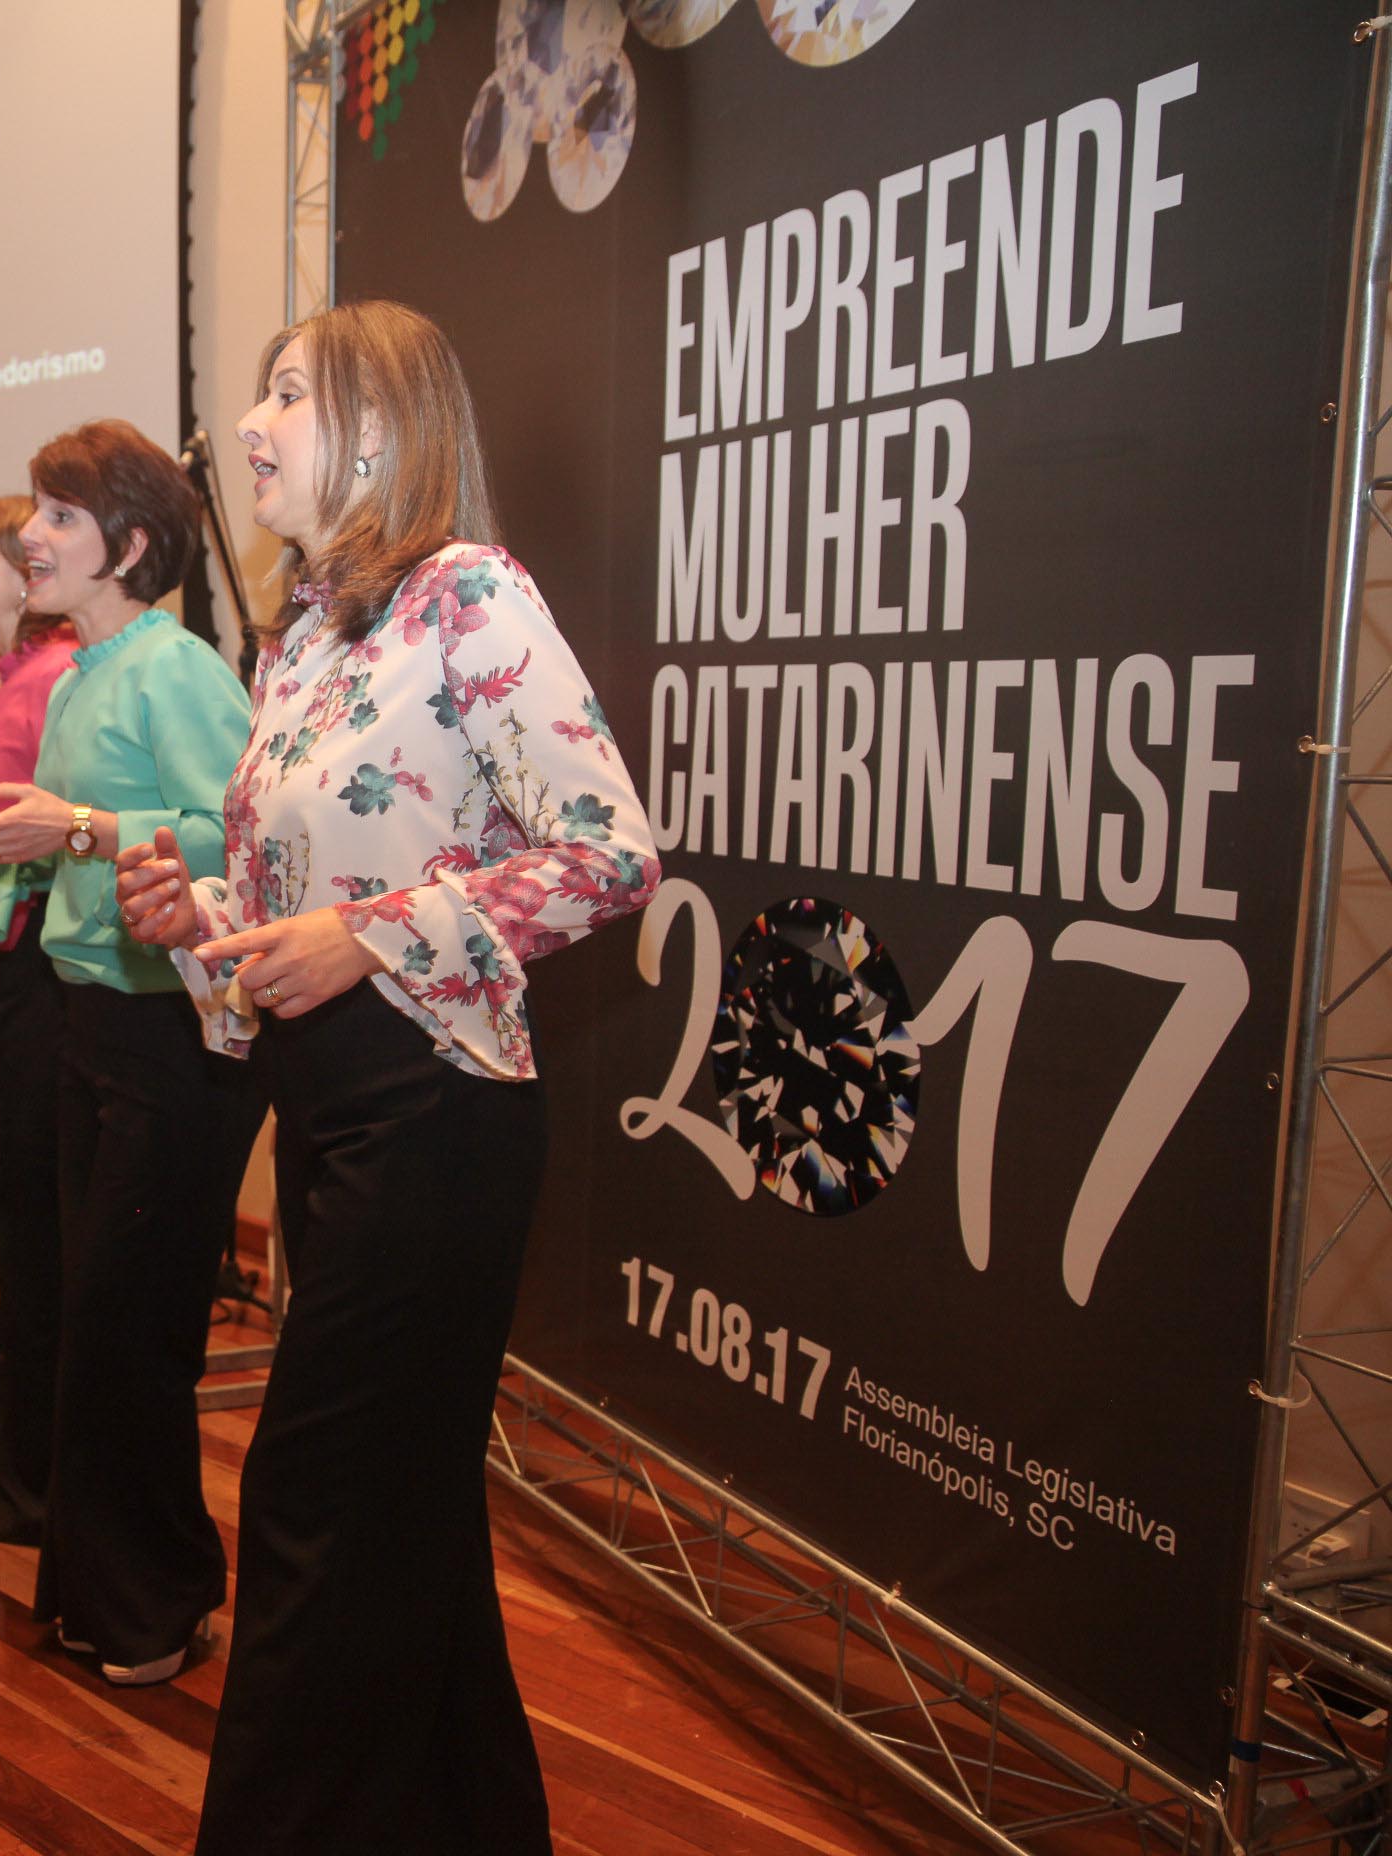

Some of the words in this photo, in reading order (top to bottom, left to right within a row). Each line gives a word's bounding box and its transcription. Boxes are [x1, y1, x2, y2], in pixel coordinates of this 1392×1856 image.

[664, 62, 1199, 442] EMPREENDE
[656, 398, 971, 643] MULHER
[648, 653, 1255, 921] CATARINENSE
[621, 1256, 832, 1421] 17.08.17
[842, 1405, 1016, 1528] Florianópolis,
[1025, 1502, 1076, 1552] SC
[844, 1365, 995, 1465] Assembleia
[1005, 1440, 1177, 1557] Legislativa
